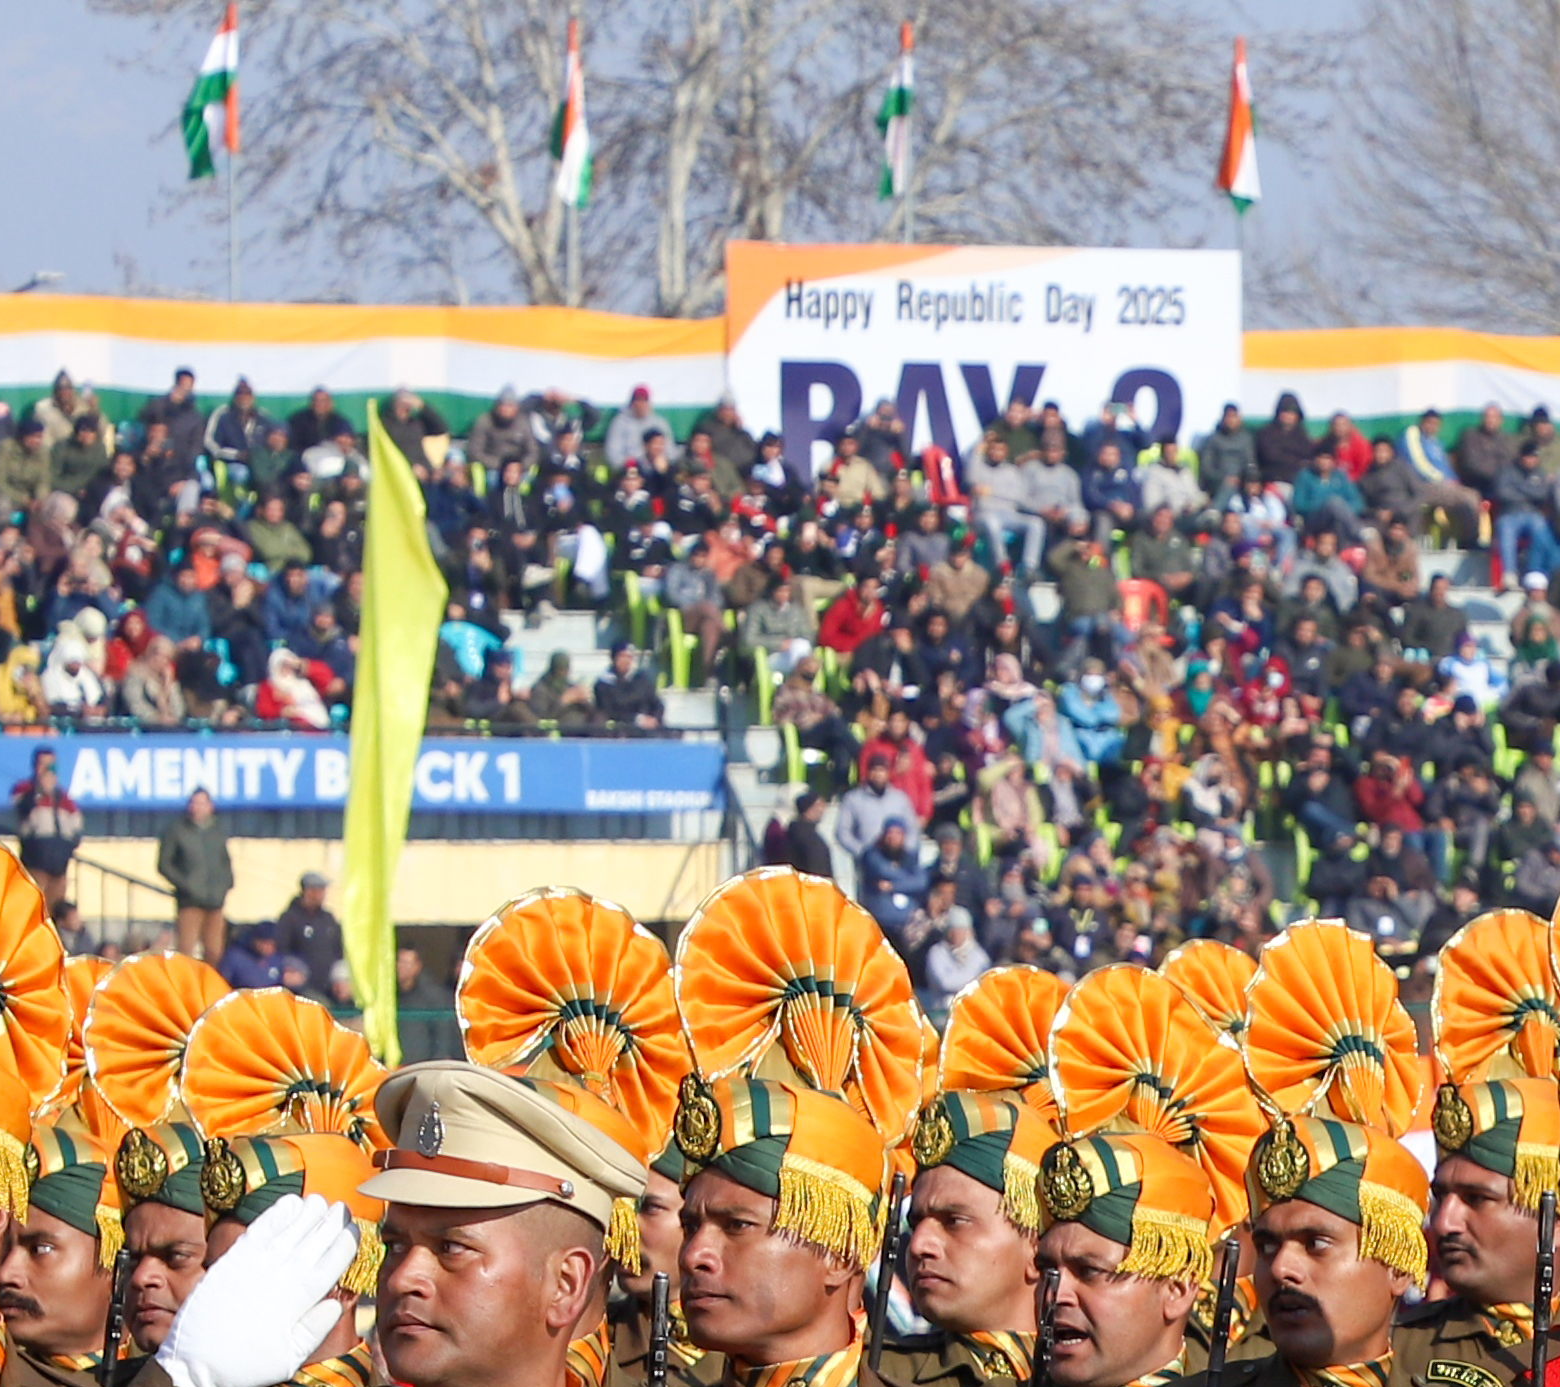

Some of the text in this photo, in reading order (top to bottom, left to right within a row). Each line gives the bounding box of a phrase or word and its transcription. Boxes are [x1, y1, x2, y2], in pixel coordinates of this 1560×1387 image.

[785, 278, 1187, 333] Happy Republic Day 2025
[68, 746, 521, 802] AMENITY BCK 1
